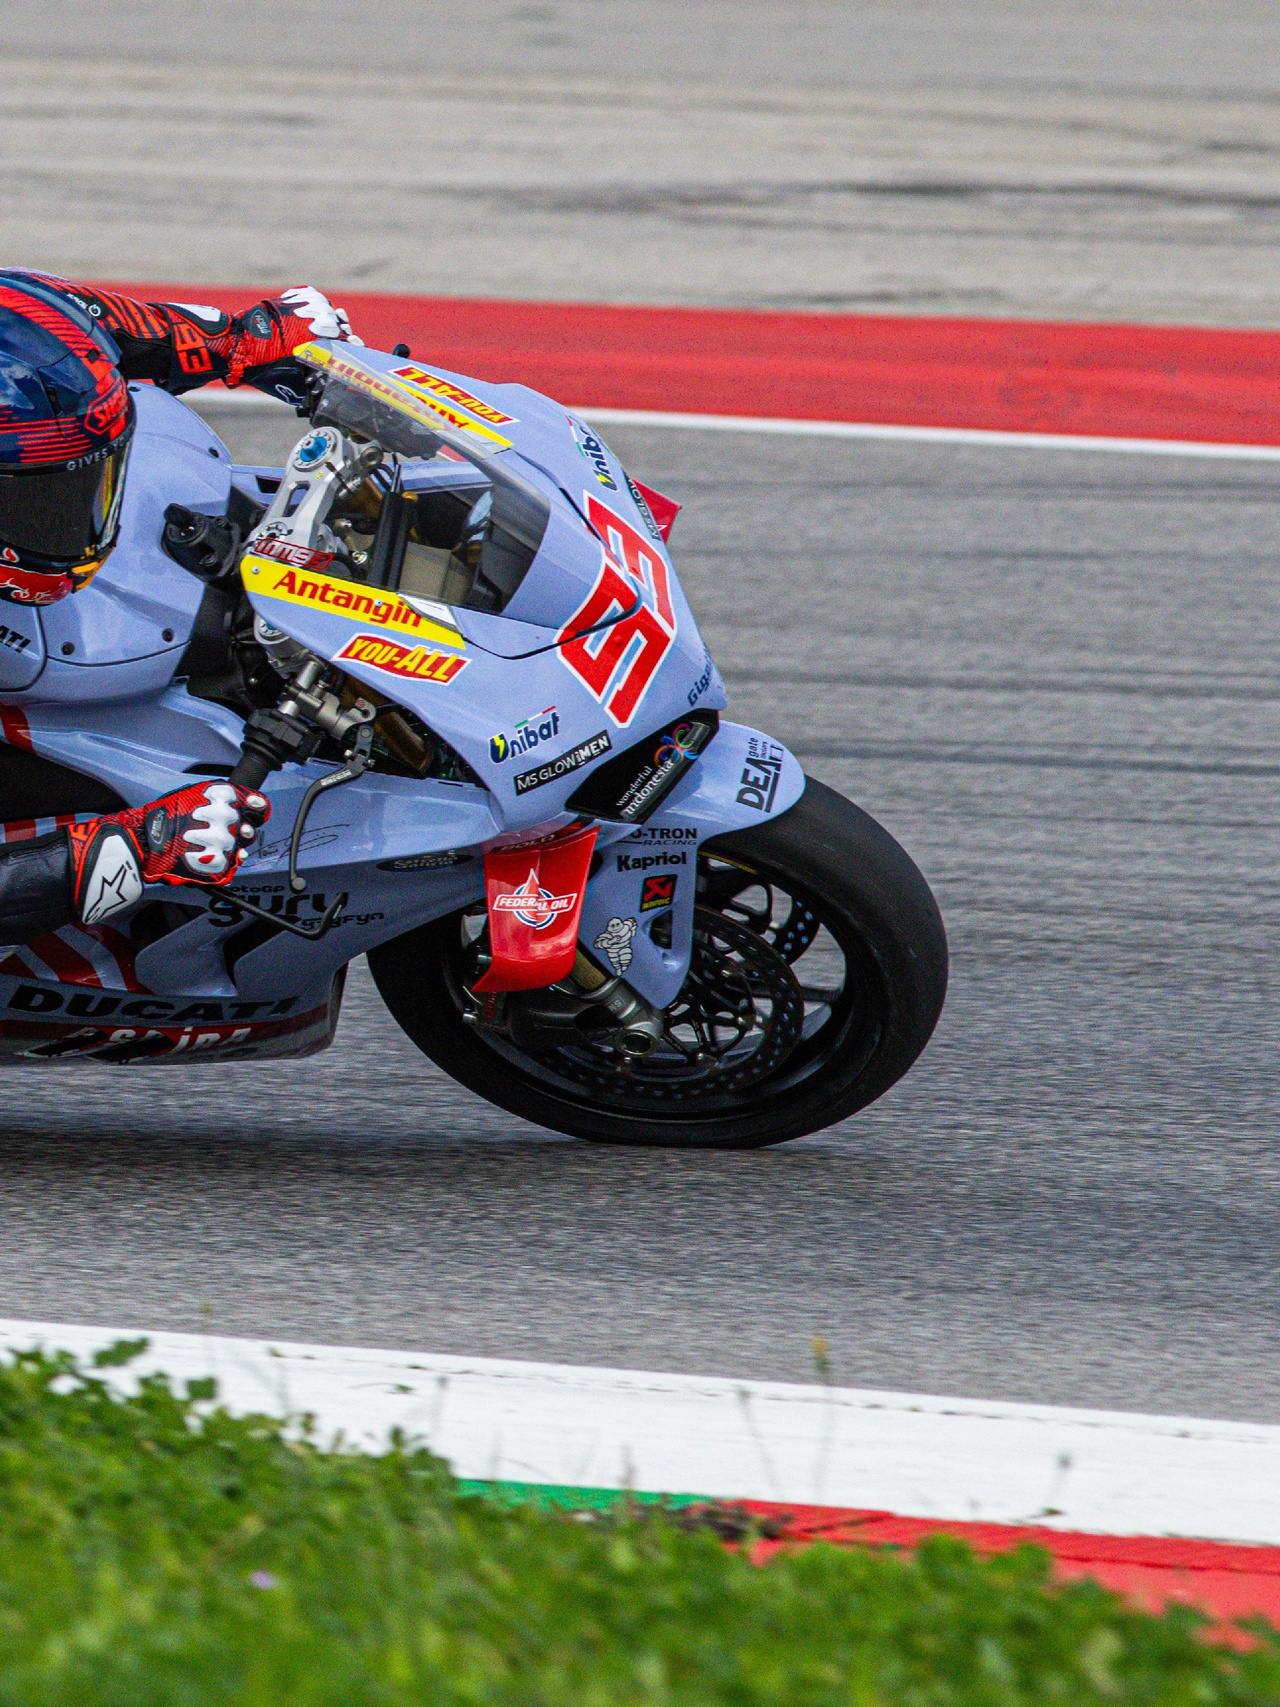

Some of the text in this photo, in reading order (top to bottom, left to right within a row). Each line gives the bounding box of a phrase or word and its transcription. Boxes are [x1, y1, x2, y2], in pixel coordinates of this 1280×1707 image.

[402, 368, 506, 423] YOU-ALL
[66, 448, 108, 471] GIVES
[273, 570, 422, 628] Antangin
[552, 488, 678, 729] 93
[347, 638, 459, 682] YOU-ALL
[489, 711, 560, 763] Unibat
[748, 737, 761, 758] gate
[517, 774, 539, 790] MS
[539, 752, 577, 779] GLOW
[616, 765, 653, 807] wonderful
[618, 852, 687, 873] Kapriol
[225, 884, 286, 893] otoGP
[498, 898, 569, 911] FEDERAL OIL
[7, 983, 300, 1022] DUCATI
